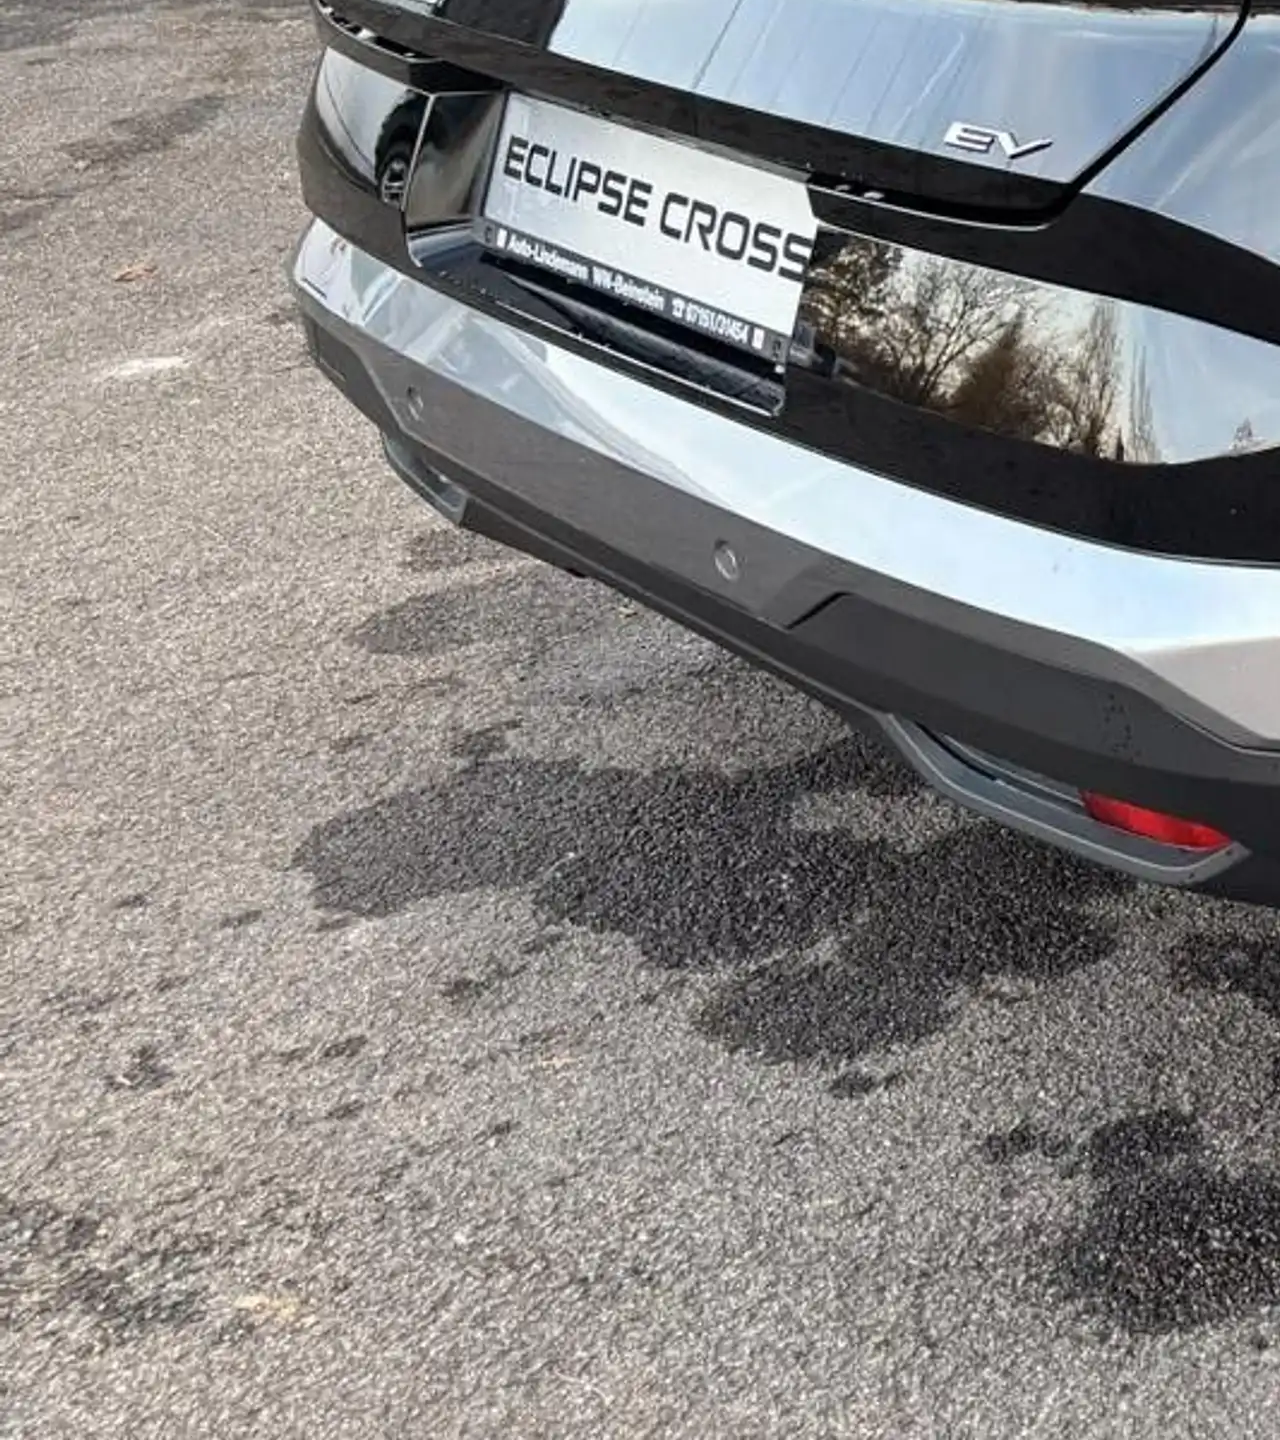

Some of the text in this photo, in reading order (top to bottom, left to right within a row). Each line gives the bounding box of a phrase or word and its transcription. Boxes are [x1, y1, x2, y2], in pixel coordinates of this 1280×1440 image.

[943, 121, 1054, 159] EV
[503, 135, 815, 282] ECLIPSE CROSS
